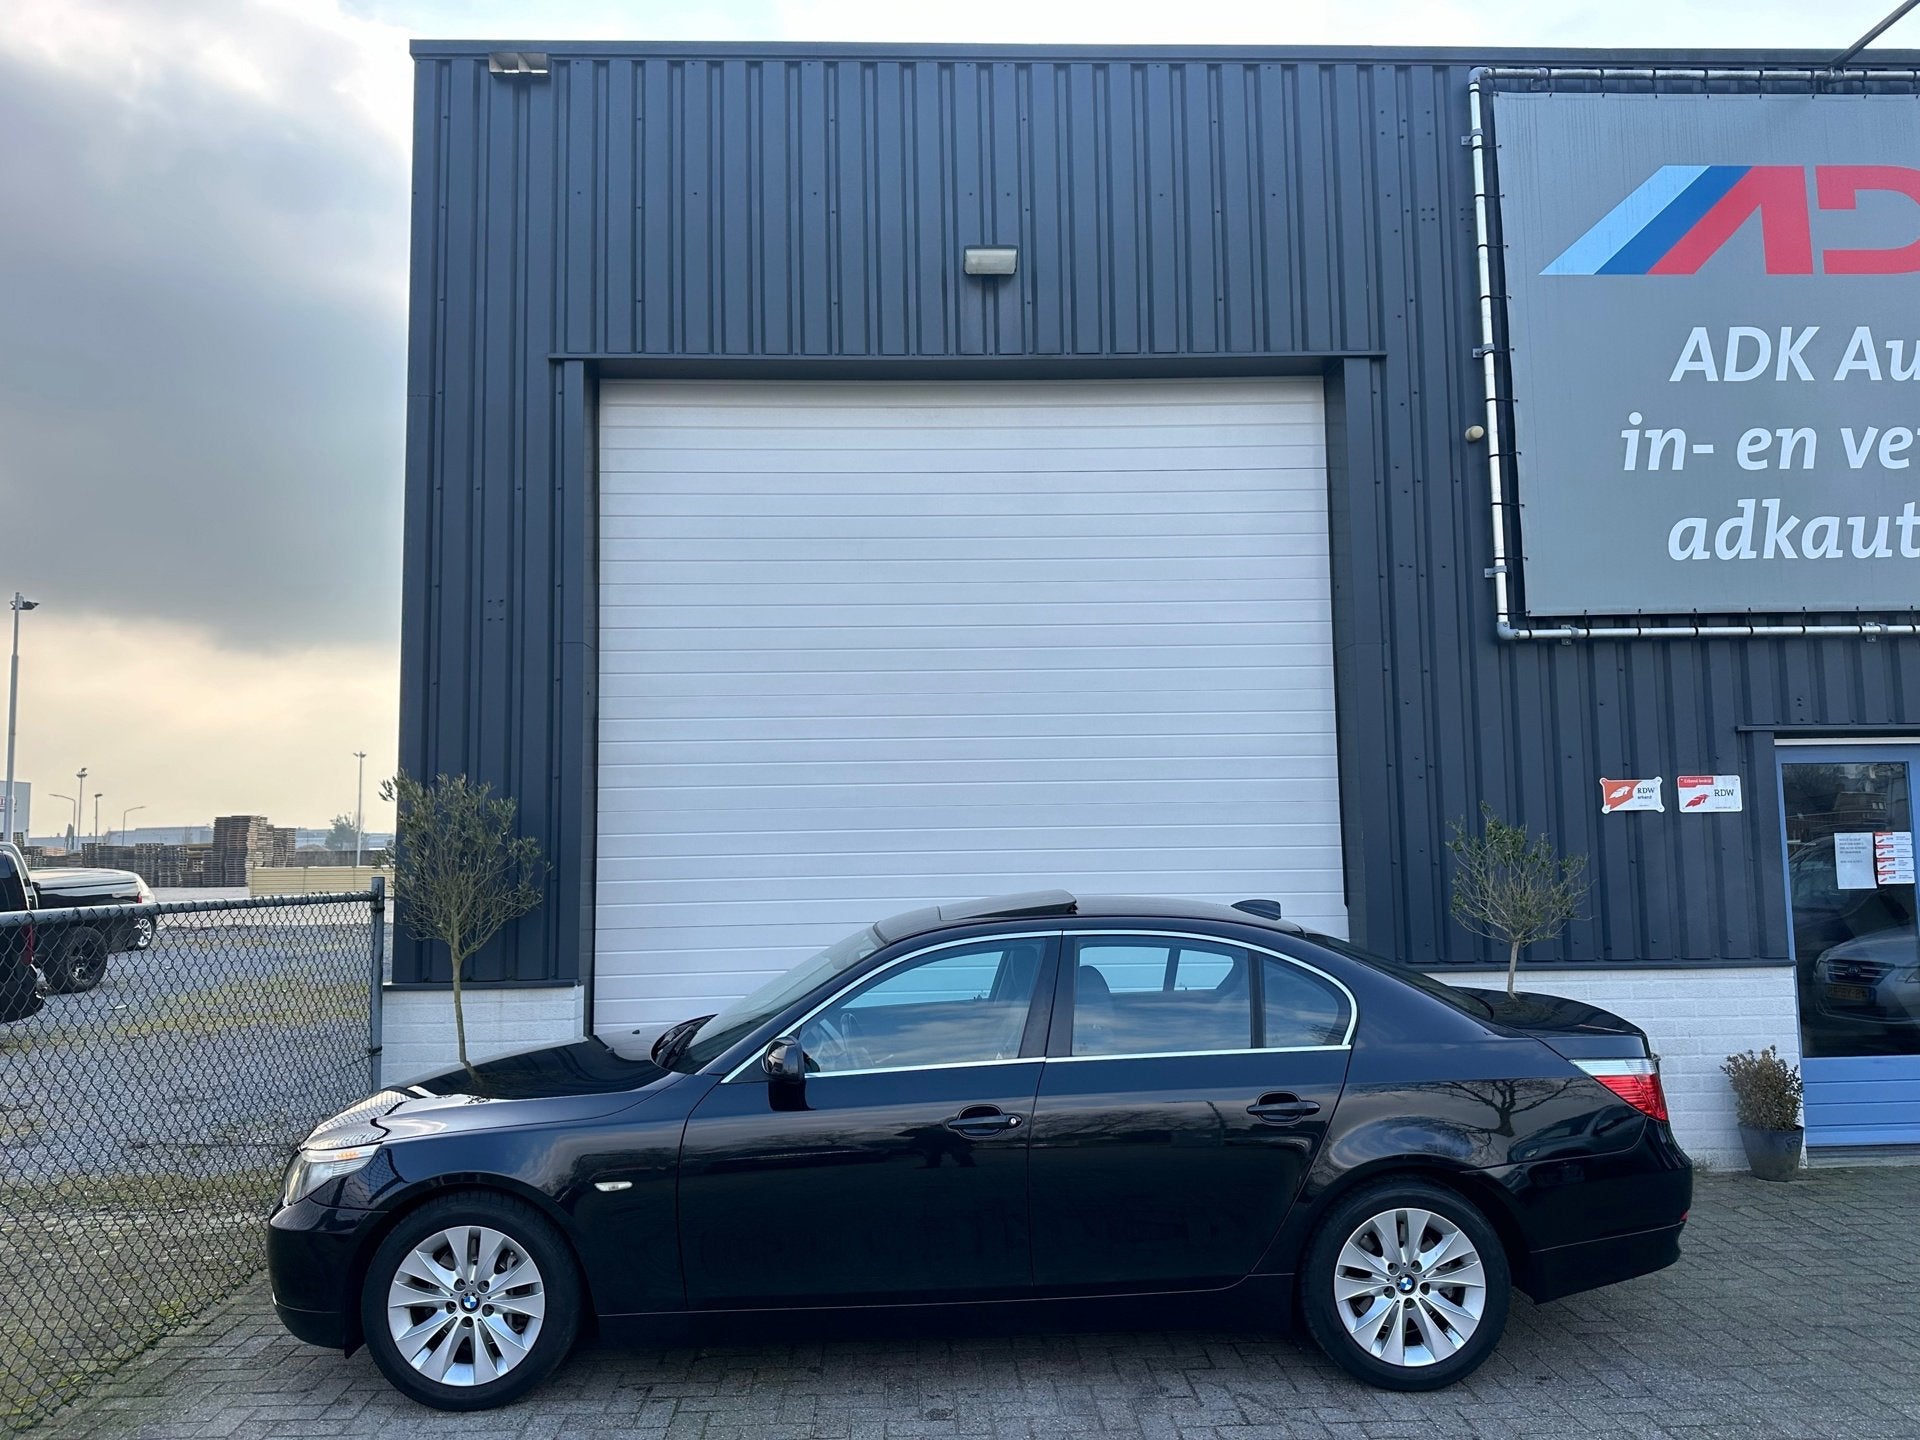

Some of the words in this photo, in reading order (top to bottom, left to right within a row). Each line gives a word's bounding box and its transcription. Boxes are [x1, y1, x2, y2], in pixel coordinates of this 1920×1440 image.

[1669, 326, 1820, 382] ADK
[1834, 326, 1920, 382] Au
[1620, 412, 1714, 471] in-
[1736, 426, 1817, 471] en
[1841, 426, 1920, 470] ve
[1667, 498, 1920, 562] adkaut
[1714, 789, 1734, 797] RDW
